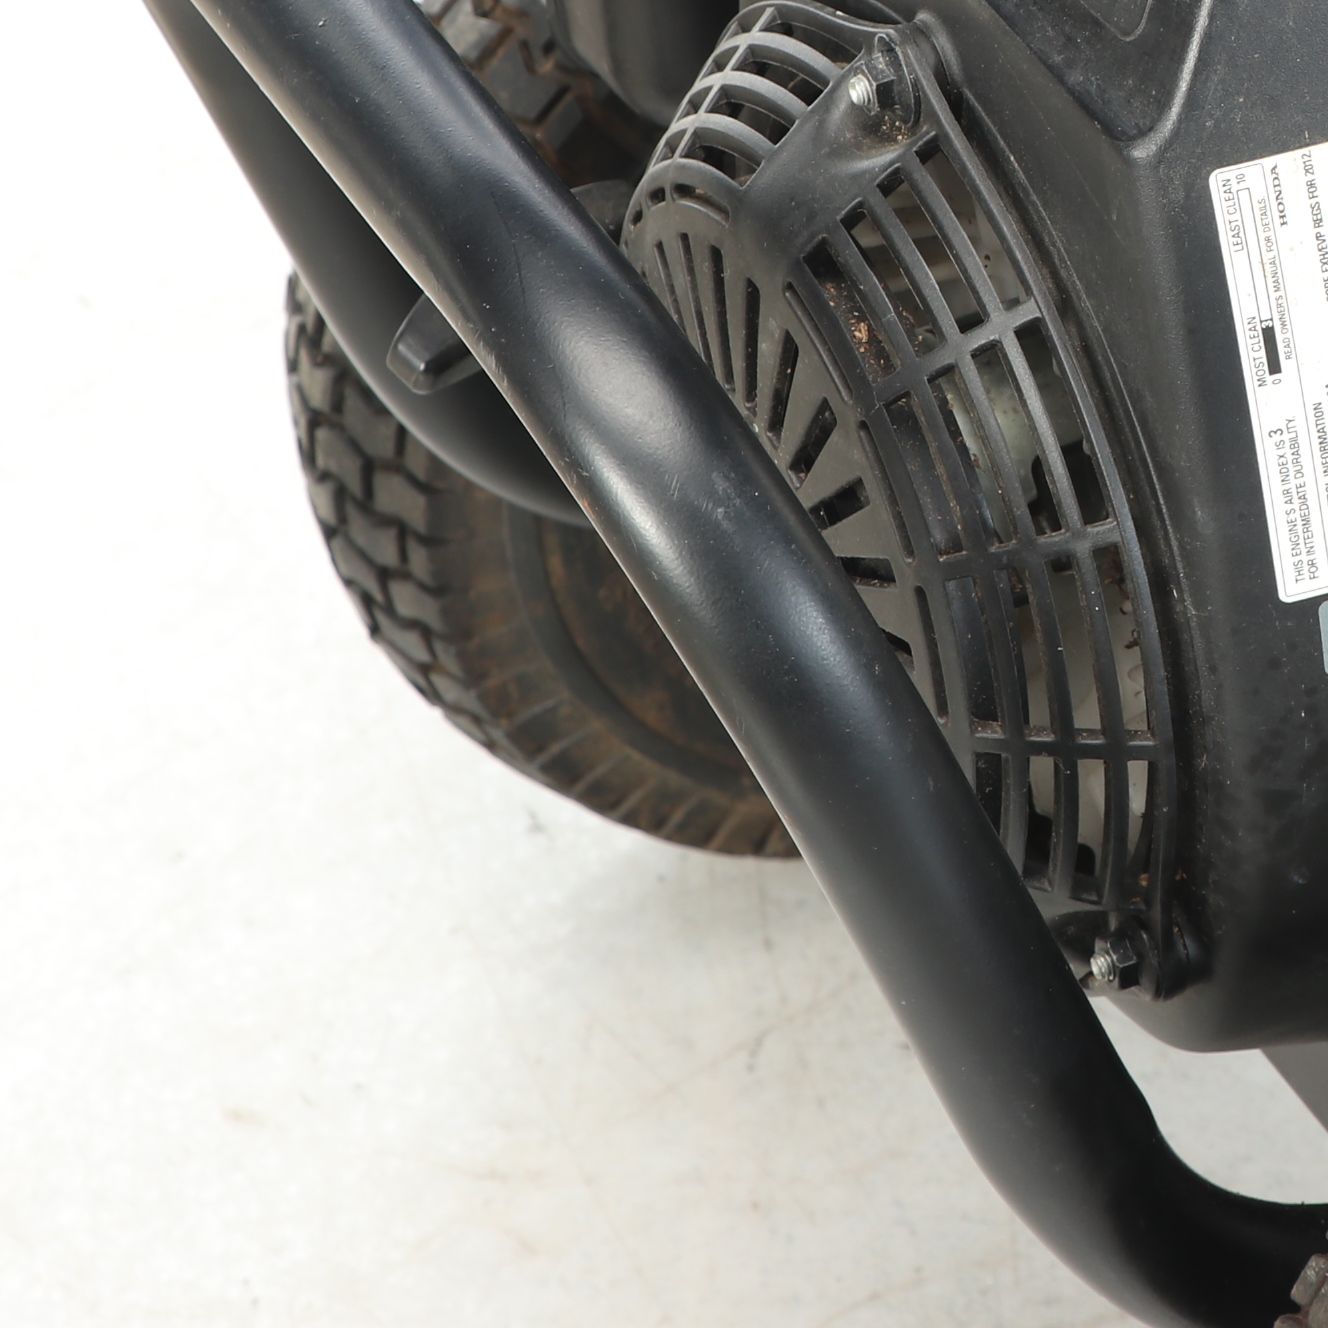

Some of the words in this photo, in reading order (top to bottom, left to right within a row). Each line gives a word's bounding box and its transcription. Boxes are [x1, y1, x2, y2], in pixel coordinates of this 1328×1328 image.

[1234, 172, 1246, 184] 10
[1305, 178, 1318, 199] FOR
[1221, 178, 1237, 215] CLEAN
[1270, 163, 1287, 226] HONDA
[1309, 201, 1323, 228] REGS
[1228, 219, 1244, 252] LEAST
[1263, 235, 1274, 252] FOR
[1268, 254, 1281, 292] MANUAL
[1274, 294, 1288, 334] OWNER'S
[1246, 316, 1261, 352] CLEAN
[1281, 337, 1292, 360] READ
[1252, 356, 1267, 387] MOST
[1271, 377, 1281, 385] 0
[1267, 428, 1283, 438] 3
[1274, 439, 1285, 450] IS
[1285, 418, 1304, 479] DURABILITY.
[1276, 452, 1290, 485] INDEX
[1281, 487, 1294, 504] AIR
[1284, 507, 1302, 557] ENGINE'S
[1294, 480, 1315, 556] INTERMEDIATE
[1292, 559, 1305, 584] THIS
[1306, 557, 1318, 580] FOR
